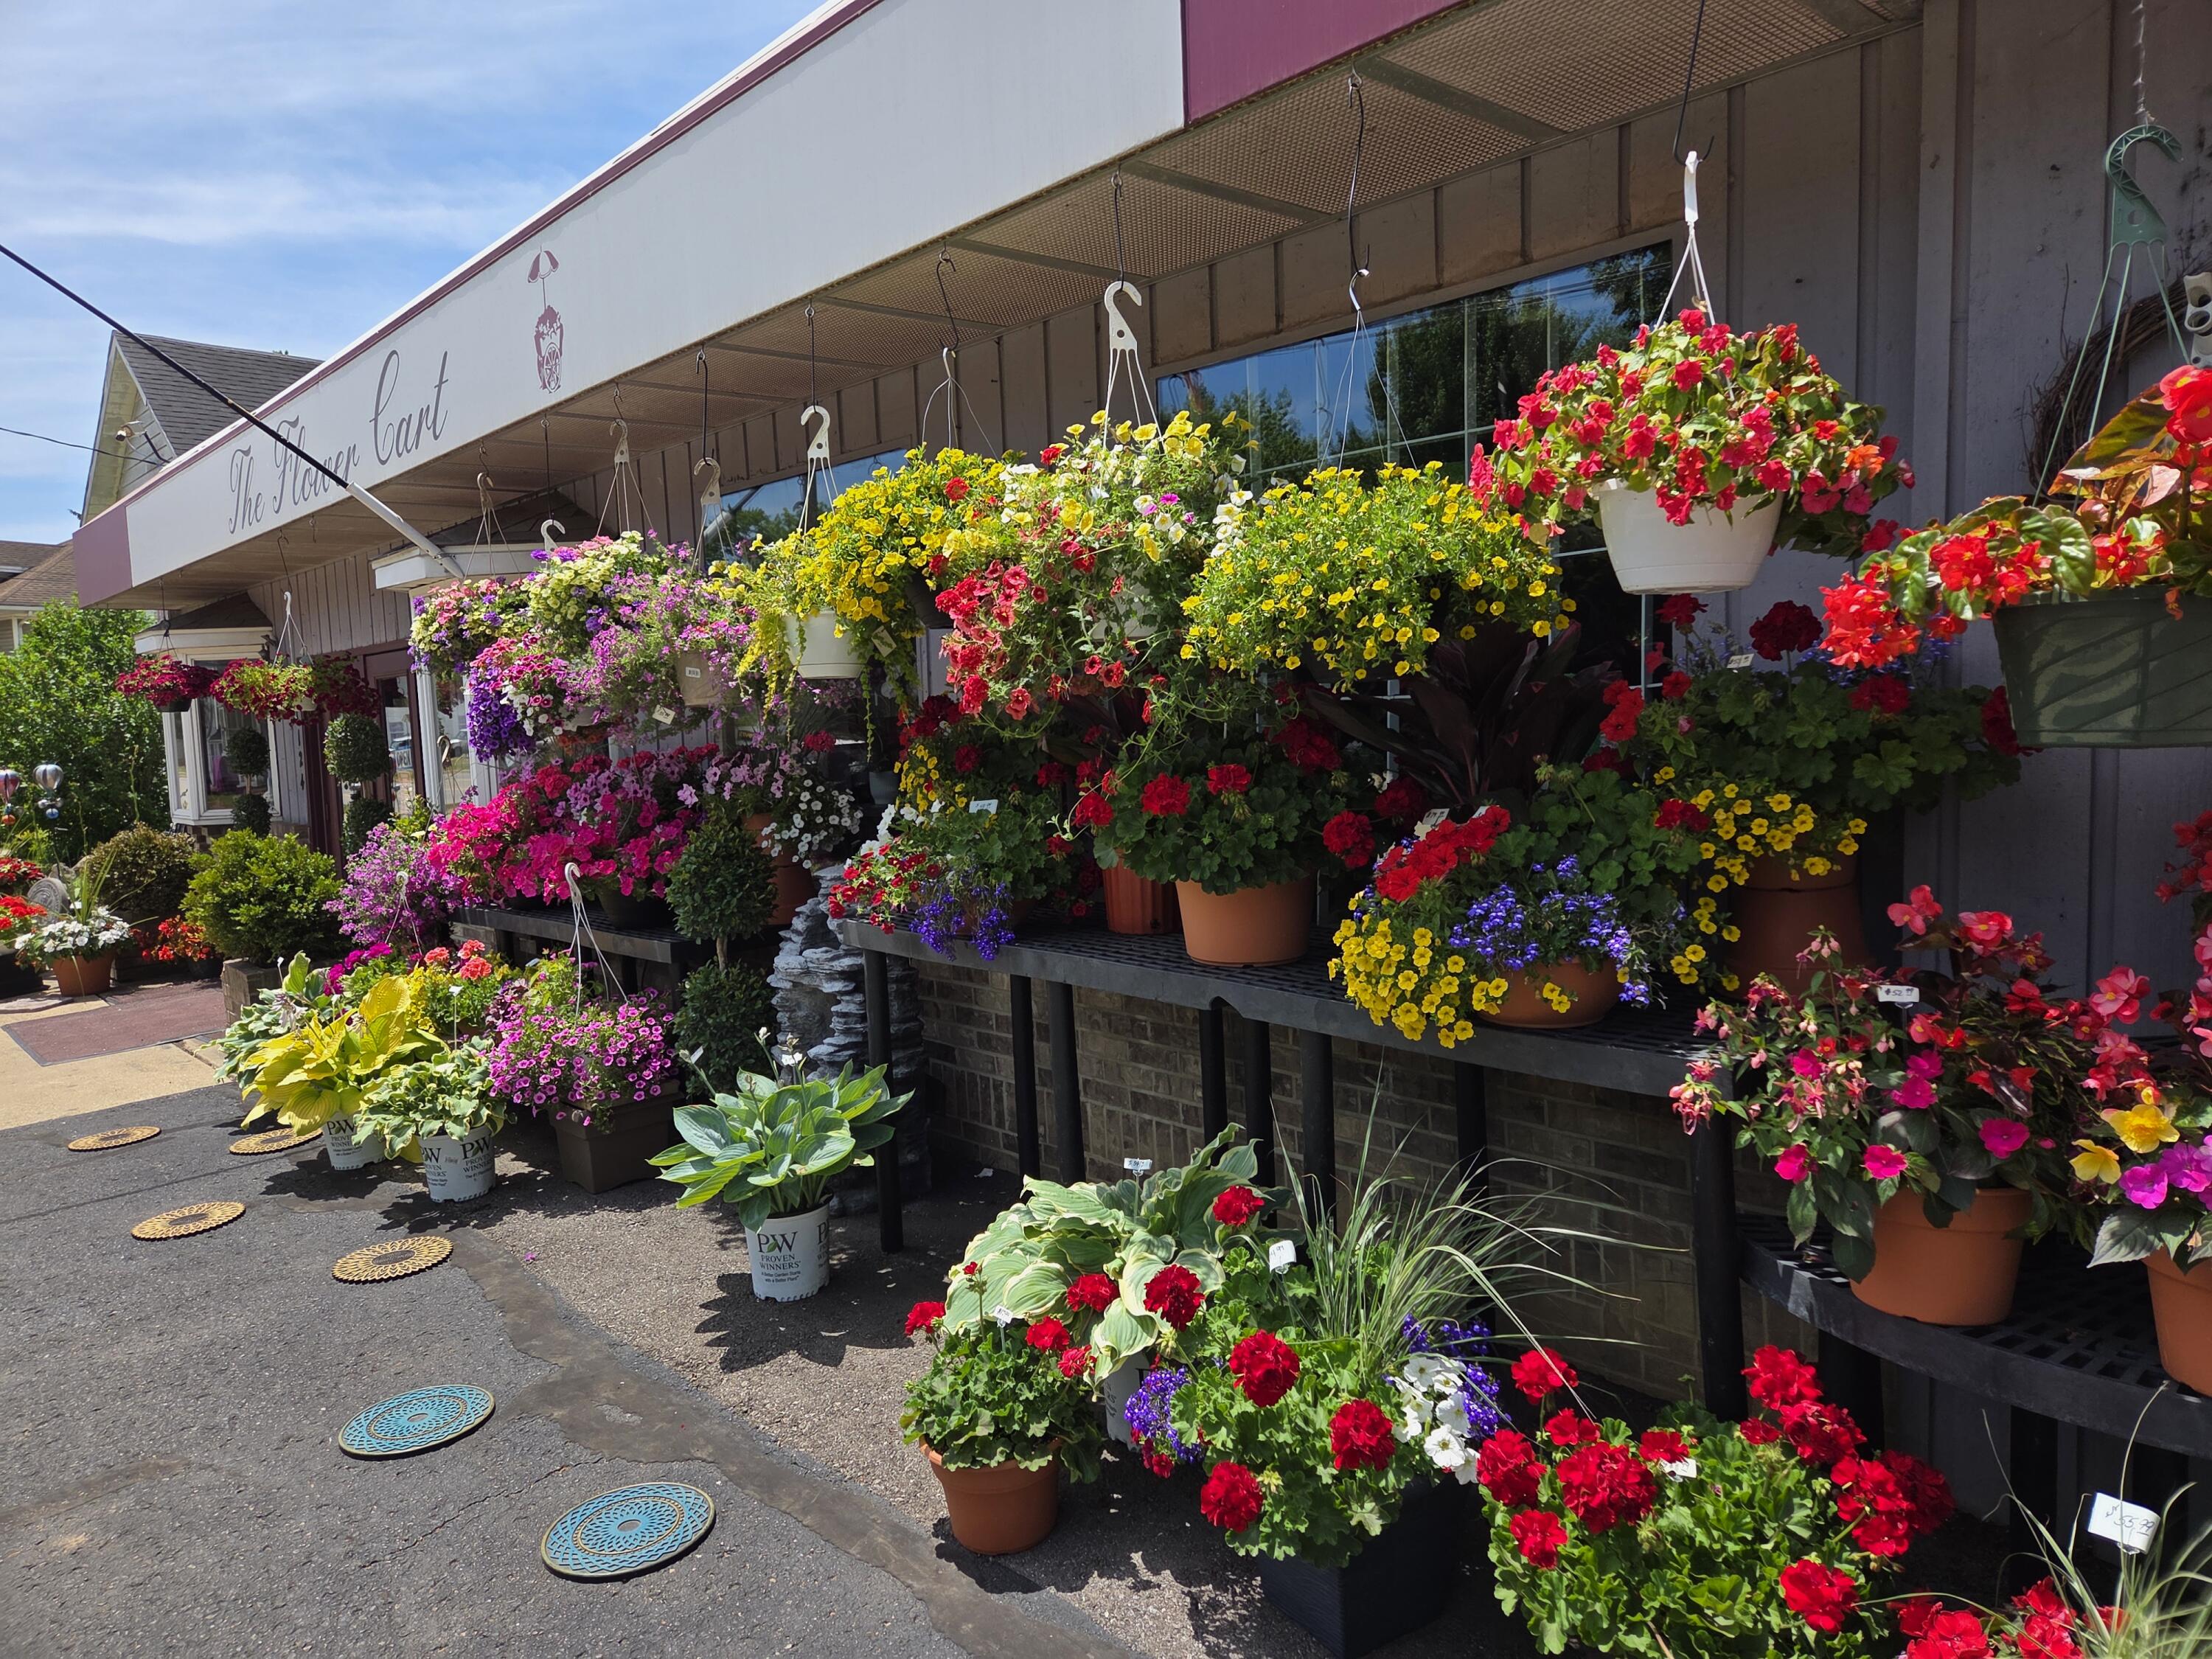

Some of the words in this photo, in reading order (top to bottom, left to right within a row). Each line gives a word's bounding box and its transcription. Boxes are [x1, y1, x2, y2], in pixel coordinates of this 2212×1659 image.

[229, 445, 265, 534] The
[272, 414, 360, 515] Flower
[369, 349, 448, 465] Cart
[757, 1231, 798, 1253] PW
[759, 1262, 799, 1270] WINNERS
[761, 1254, 795, 1263] PROVEN
